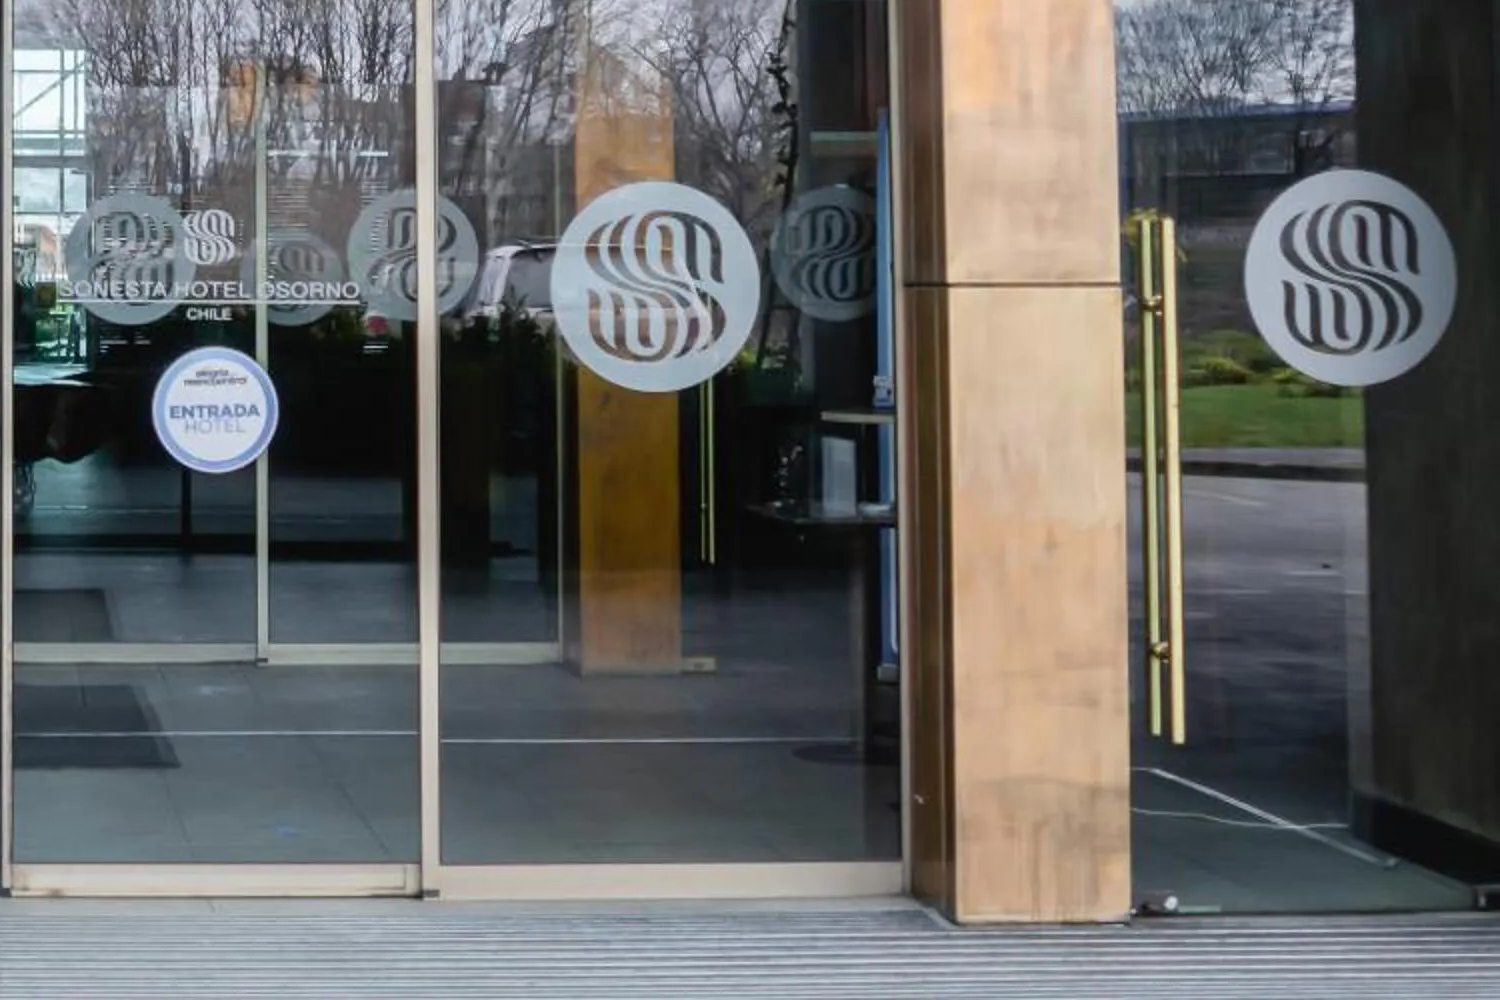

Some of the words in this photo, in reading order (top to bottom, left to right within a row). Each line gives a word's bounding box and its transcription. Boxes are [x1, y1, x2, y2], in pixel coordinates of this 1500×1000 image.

[60, 282, 167, 299] SONESTA
[175, 282, 251, 299] HOTEL
[257, 282, 360, 299] OSORNO
[186, 308, 233, 321] CHILE
[169, 403, 261, 419] ENTRADA
[185, 419, 245, 433] HOTEL
